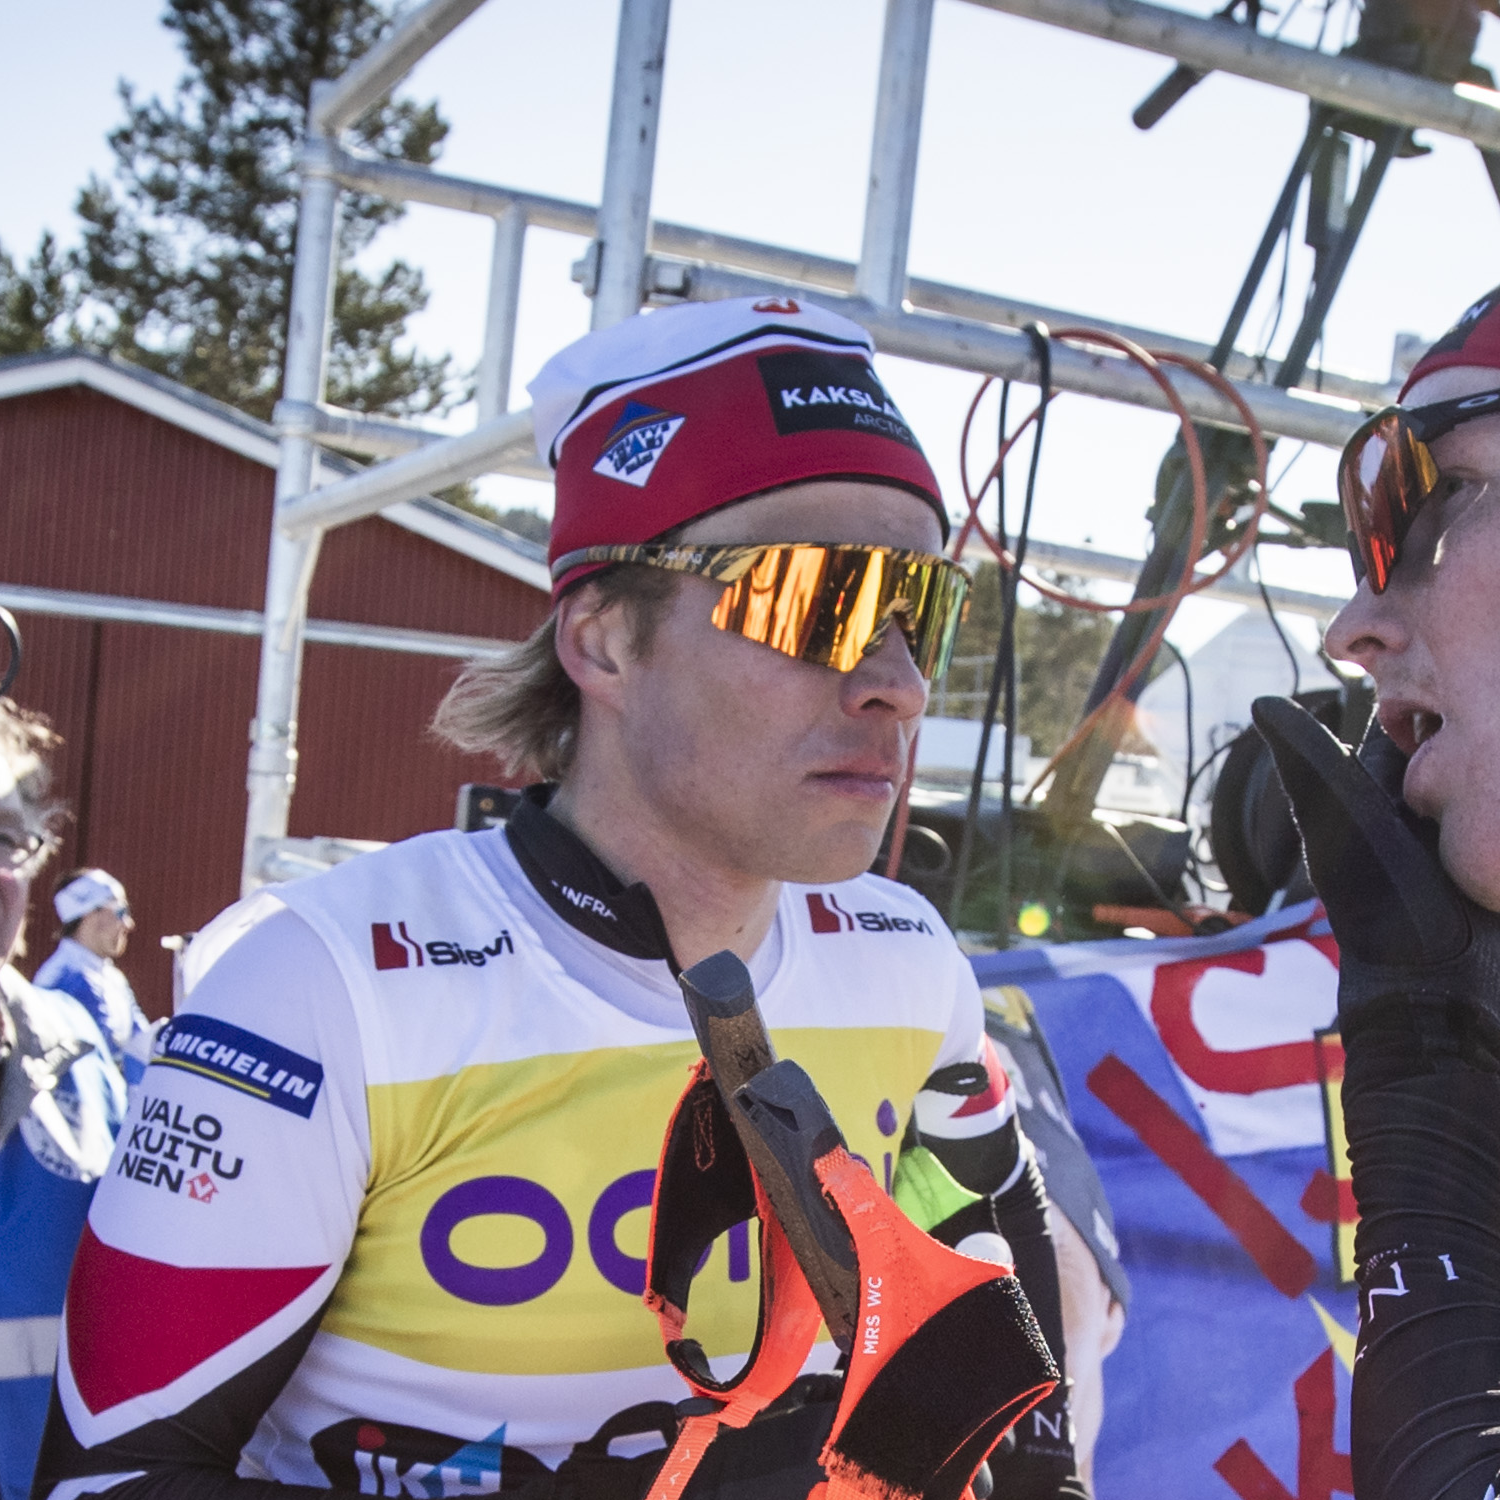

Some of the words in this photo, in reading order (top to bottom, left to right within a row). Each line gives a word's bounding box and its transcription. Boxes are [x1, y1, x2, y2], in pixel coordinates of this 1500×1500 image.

[855, 911, 935, 937] Sievi
[425, 929, 515, 967] Sievi
[167, 1032, 317, 1100] MICHELIN
[140, 1096, 223, 1143] VALO
[116, 1151, 186, 1194] NEN
[127, 1123, 244, 1181] KUITU
[866, 1276, 884, 1308] WC
[862, 1313, 881, 1355] MRS
